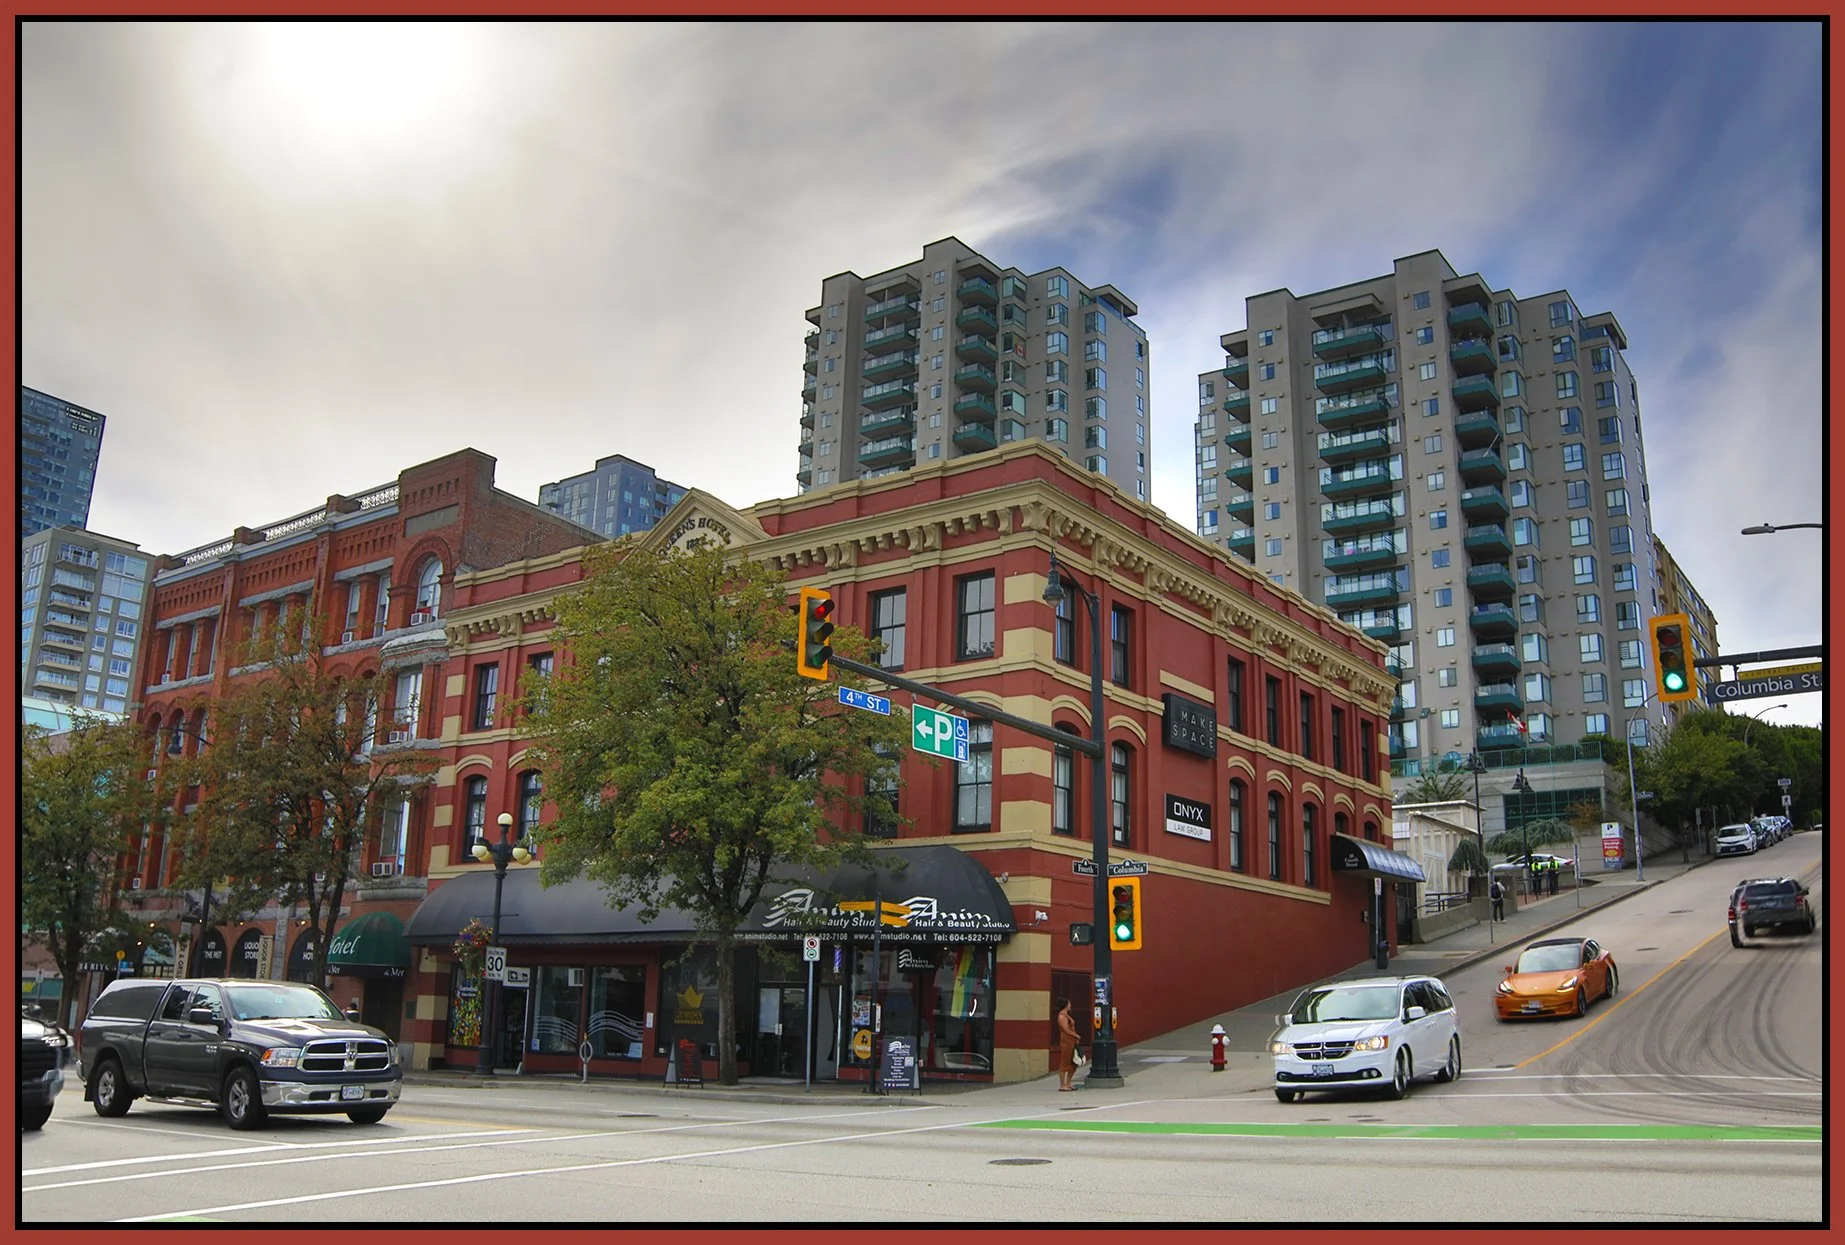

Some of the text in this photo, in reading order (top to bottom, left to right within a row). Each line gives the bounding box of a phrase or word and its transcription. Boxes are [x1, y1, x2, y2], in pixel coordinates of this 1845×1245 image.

[1715, 676, 1794, 698] Columbia
[846, 691, 884, 711] 4TH ST.
[1180, 710, 1213, 732] MAKE
[934, 713, 953, 752] P
[1172, 724, 1213, 749] SPACE
[1173, 801, 1204, 823] ONYX
[1174, 823, 1204, 837] LAW GROUP
[1077, 864, 1094, 874] Fourth
[1113, 864, 1144, 875] Columbia
[947, 920, 980, 929] Beauty
[243, 941, 259, 950] LIQUO
[853, 933, 1002, 942] www.amstudio.net Tel: 604-522-7108
[487, 956, 503, 972] 30
